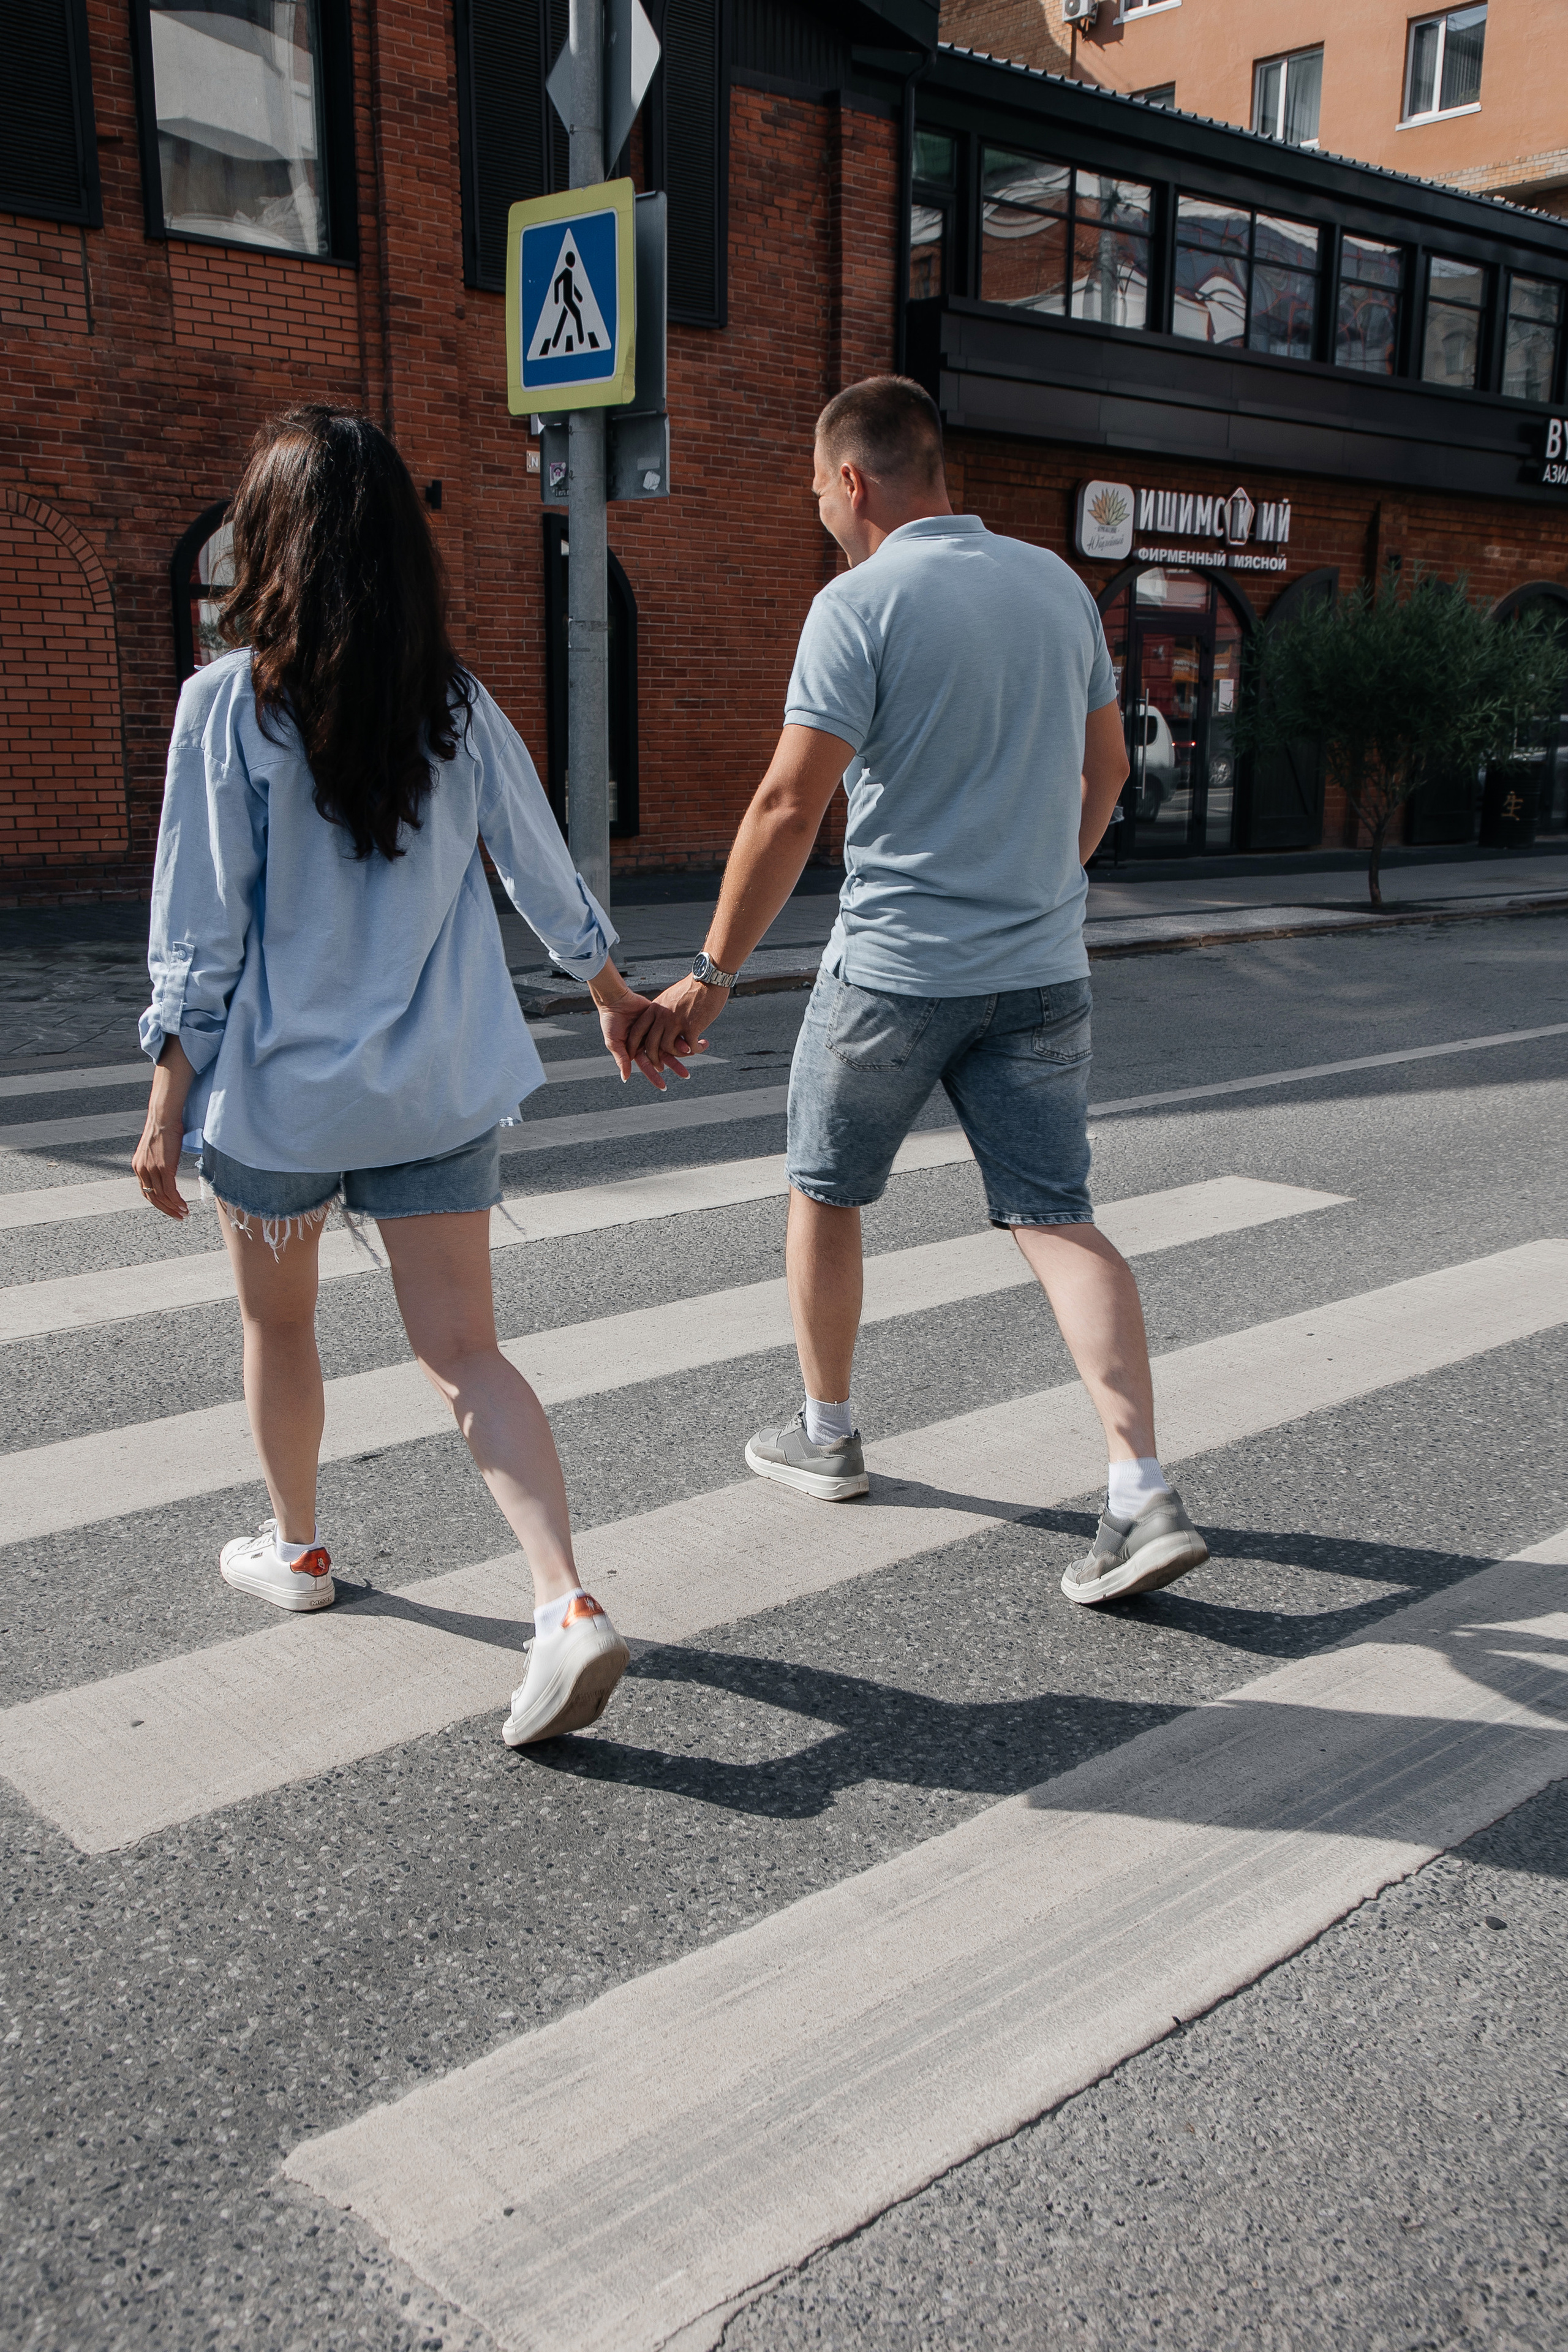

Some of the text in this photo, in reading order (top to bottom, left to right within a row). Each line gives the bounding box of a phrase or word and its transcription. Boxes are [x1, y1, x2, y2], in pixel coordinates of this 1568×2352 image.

[1542, 464, 1568, 484] АЗИ
[1138, 488, 1291, 543] ИШИМСКИЙ
[1137, 547, 1287, 571] ФИРМЕННЫЙ МЯСНОЙ
